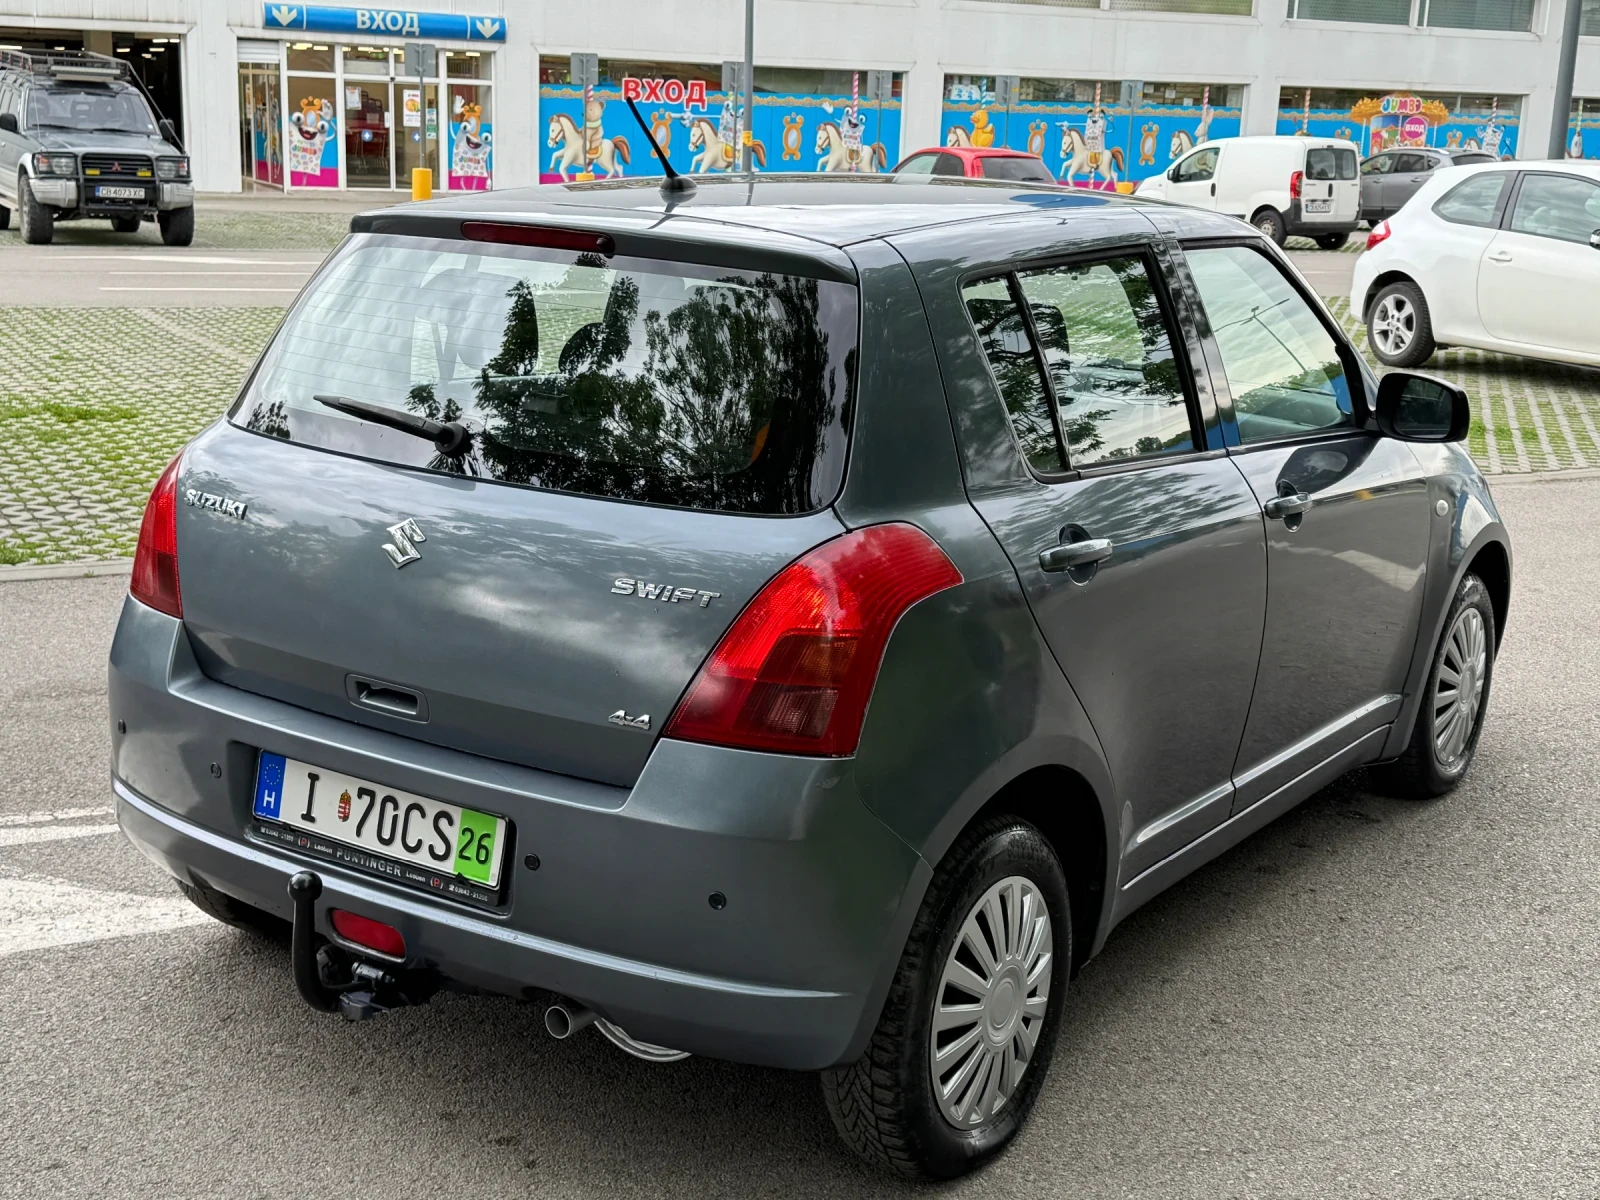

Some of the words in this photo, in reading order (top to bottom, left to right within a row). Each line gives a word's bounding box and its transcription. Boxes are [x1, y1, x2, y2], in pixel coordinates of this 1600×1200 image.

[356, 9, 420, 36] ВХОД
[622, 78, 707, 111] ВХОД
[1381, 97, 1422, 114] JUMBO
[1405, 124, 1425, 133] ВХОД
[184, 488, 248, 520] SUZUKI
[611, 577, 721, 608] SWIFT
[263, 789, 276, 809] H
[355, 786, 454, 862] 70CS
[458, 827, 491, 865] 26
